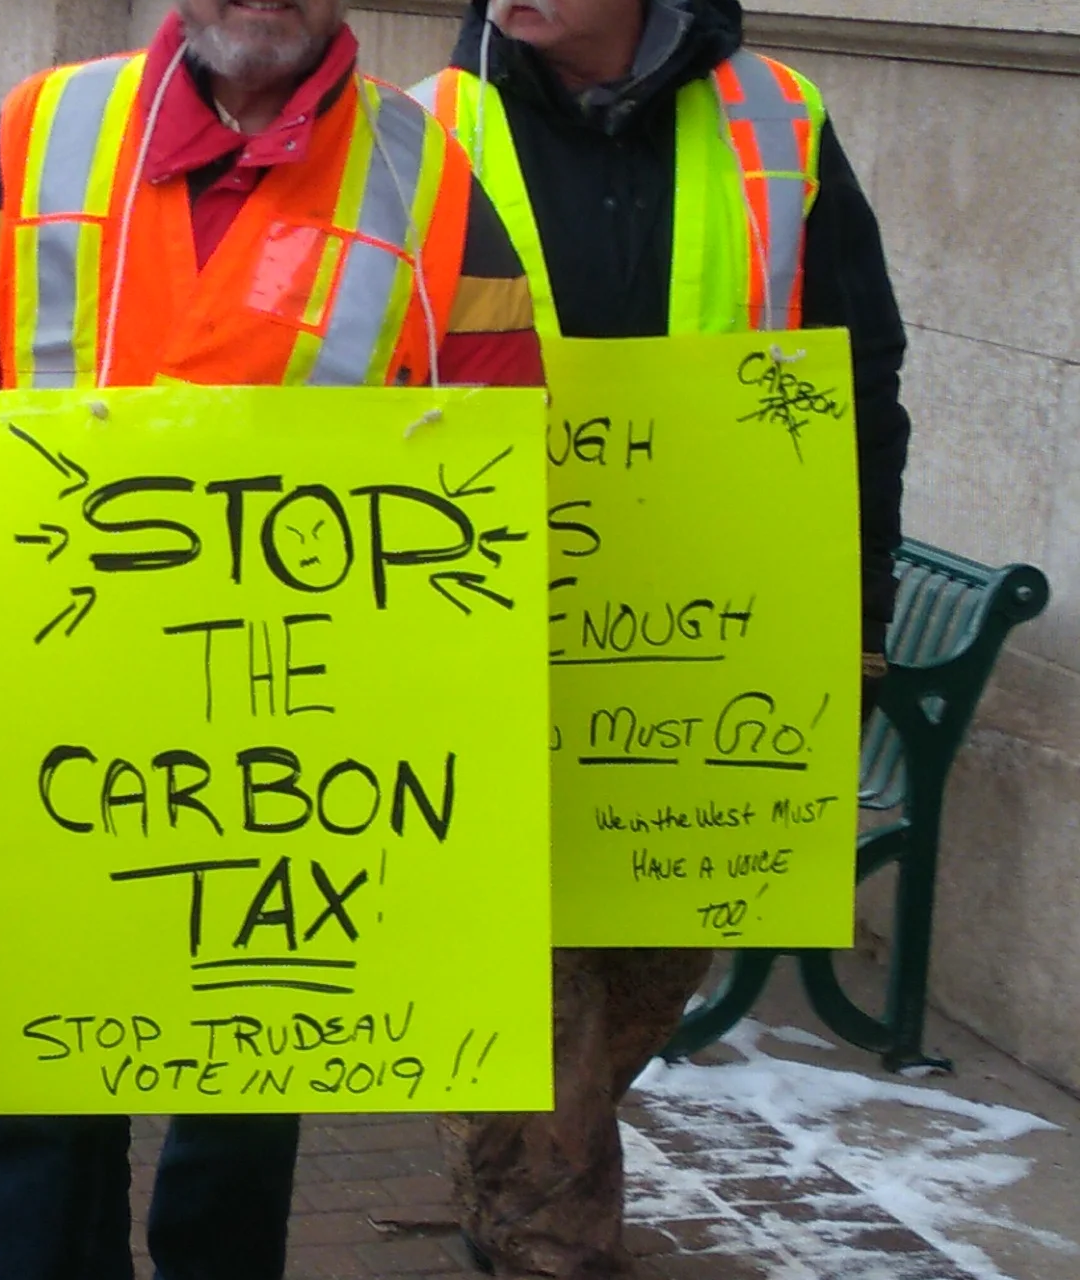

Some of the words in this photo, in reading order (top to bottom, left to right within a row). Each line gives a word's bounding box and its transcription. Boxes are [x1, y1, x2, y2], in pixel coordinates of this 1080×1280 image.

[546, 416, 653, 470] UGH
[81, 474, 475, 611] STOP
[547, 500, 601, 558] S
[162, 612, 336, 722] THE
[589, 706, 703, 754] MUST
[714, 691, 829, 756] GO!
[37, 744, 456, 844] CARBON
[595, 805, 627, 831] We
[651, 806, 692, 831] the
[695, 801, 755, 828] West
[772, 796, 838, 824] MUST
[632, 848, 687, 882] HAVE
[699, 856, 714, 878] A
[727, 848, 793, 879] VOICE
[22, 1014, 162, 1062] STOP
[190, 1001, 415, 1059] TRUDEAU
[101, 1055, 229, 1096] VOTE
[240, 1066, 294, 1095] IN
